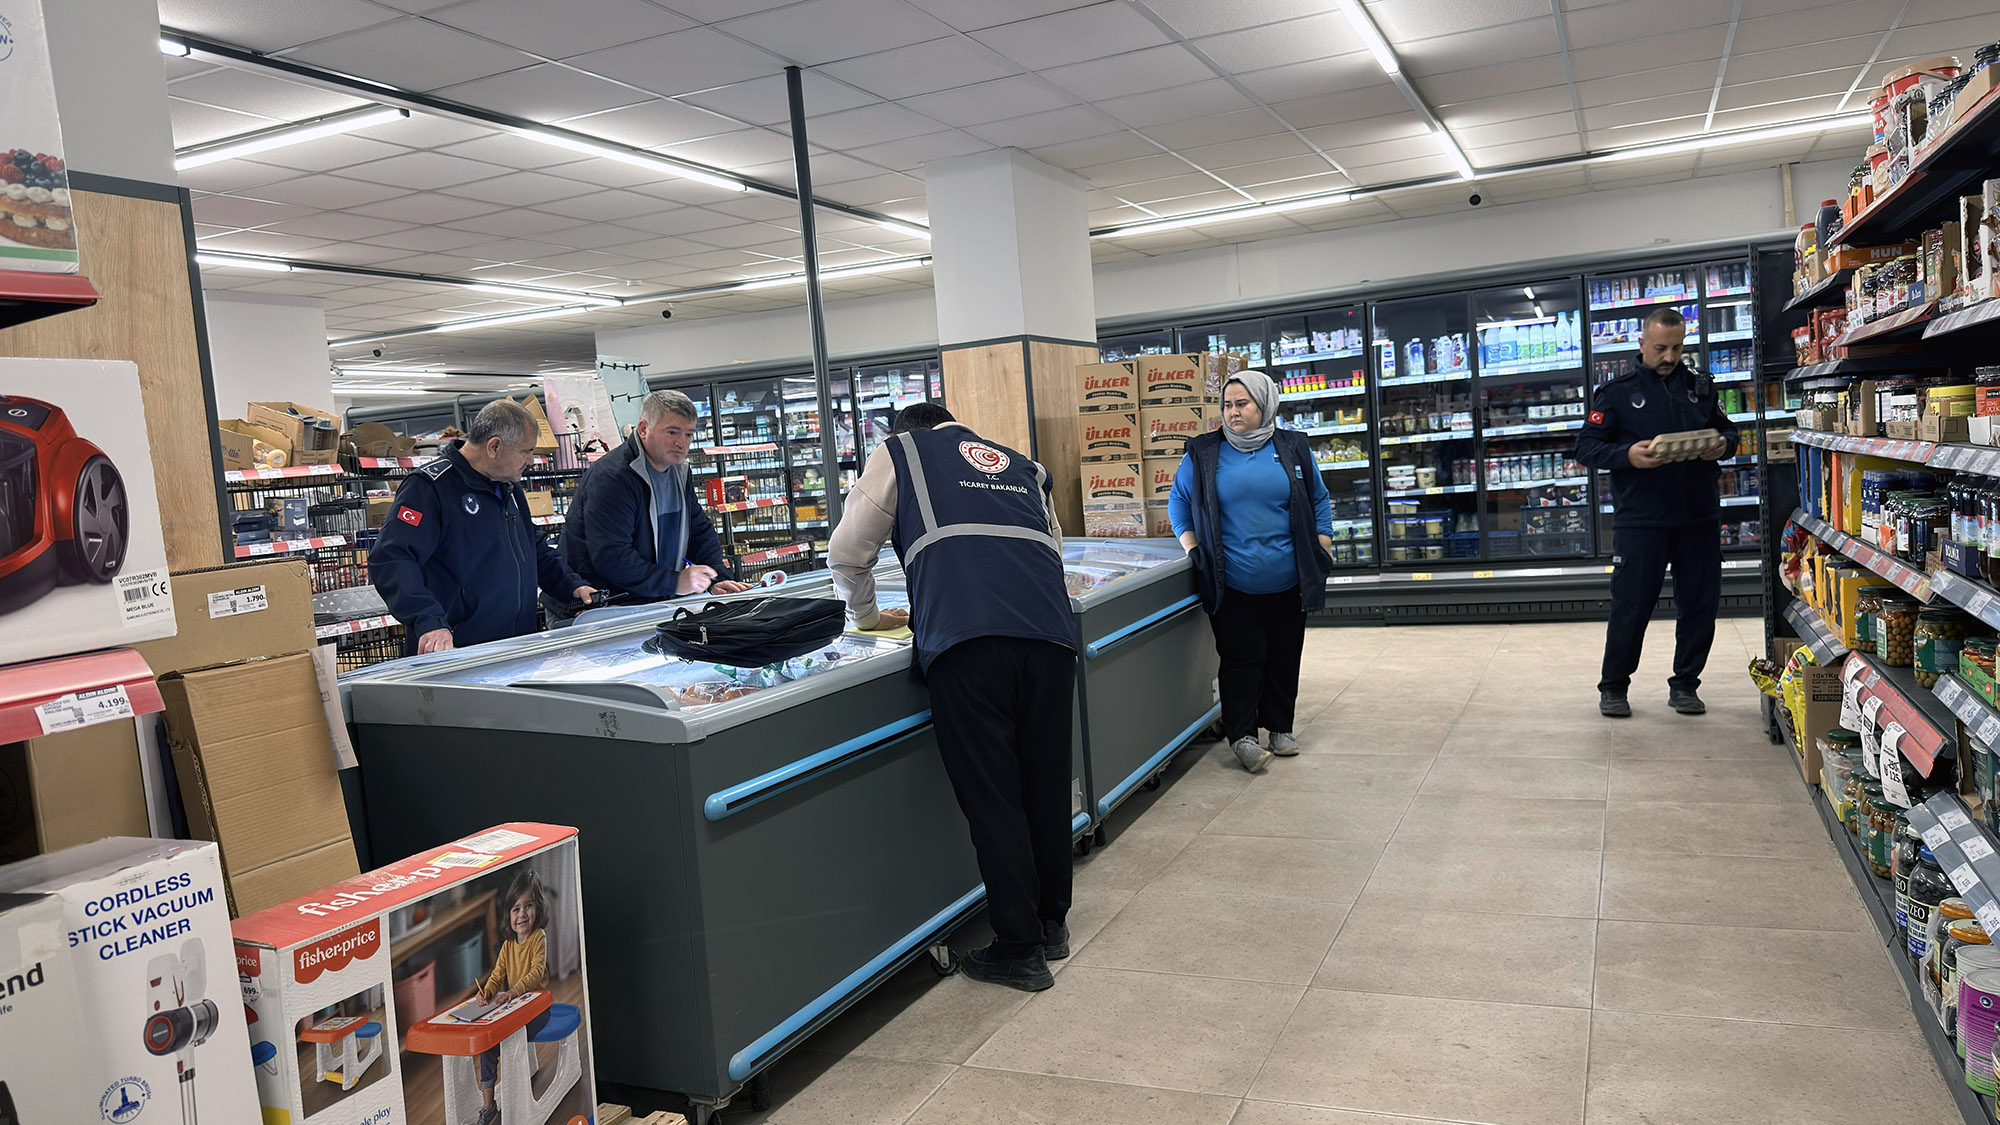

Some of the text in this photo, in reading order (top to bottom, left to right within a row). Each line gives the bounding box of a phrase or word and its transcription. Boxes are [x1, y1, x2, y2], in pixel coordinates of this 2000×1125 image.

[1084, 376, 1130, 390] ÜLKER
[1147, 368, 1195, 383] ÜLKER
[1086, 426, 1131, 441] ÜLKER
[1151, 419, 1198, 433] ÜLKER
[1090, 475, 1135, 490] ÜLKER
[1154, 469, 1176, 484] ÜL
[959, 480, 1028, 494] TİCARET BAKANLIĞI
[246, 594, 263, 603] 1.790
[98, 697, 126, 709] 4.199
[85, 872, 192, 917] CORDLESS
[67, 887, 214, 948] STICK VACUUM
[1909, 903, 1925, 920] ZEO
[99, 918, 192, 961] CLEANER
[298, 930, 376, 970] fisher-price
[373, 1106, 391, 1124] play
